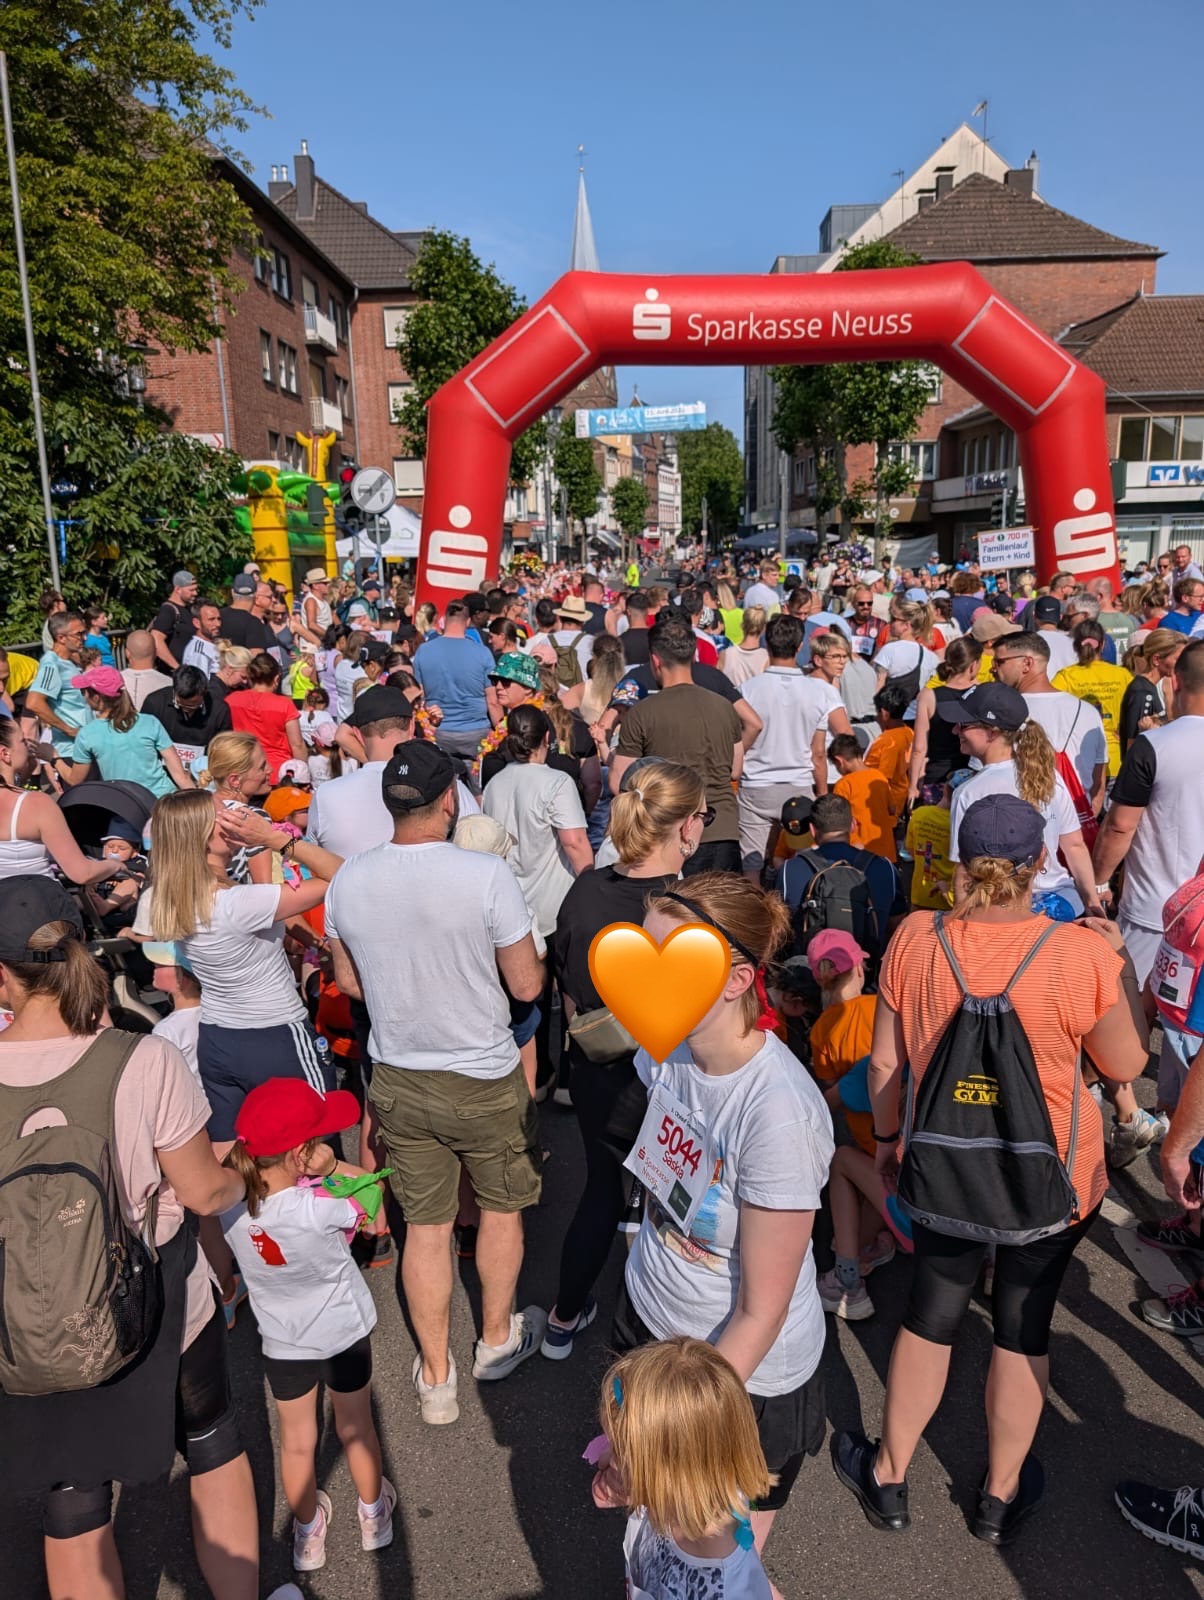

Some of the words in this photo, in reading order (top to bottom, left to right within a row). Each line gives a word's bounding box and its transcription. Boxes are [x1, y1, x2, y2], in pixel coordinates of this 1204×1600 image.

[687, 311, 823, 347] Sparkasse
[831, 310, 913, 337] Neuss
[1007, 532, 1021, 540] 700
[982, 555, 1005, 564] Eltern
[1014, 551, 1031, 560] Kind
[983, 541, 1028, 553] Familienlauf
[657, 1115, 702, 1177] 5044
[662, 1150, 684, 1180] Saskia
